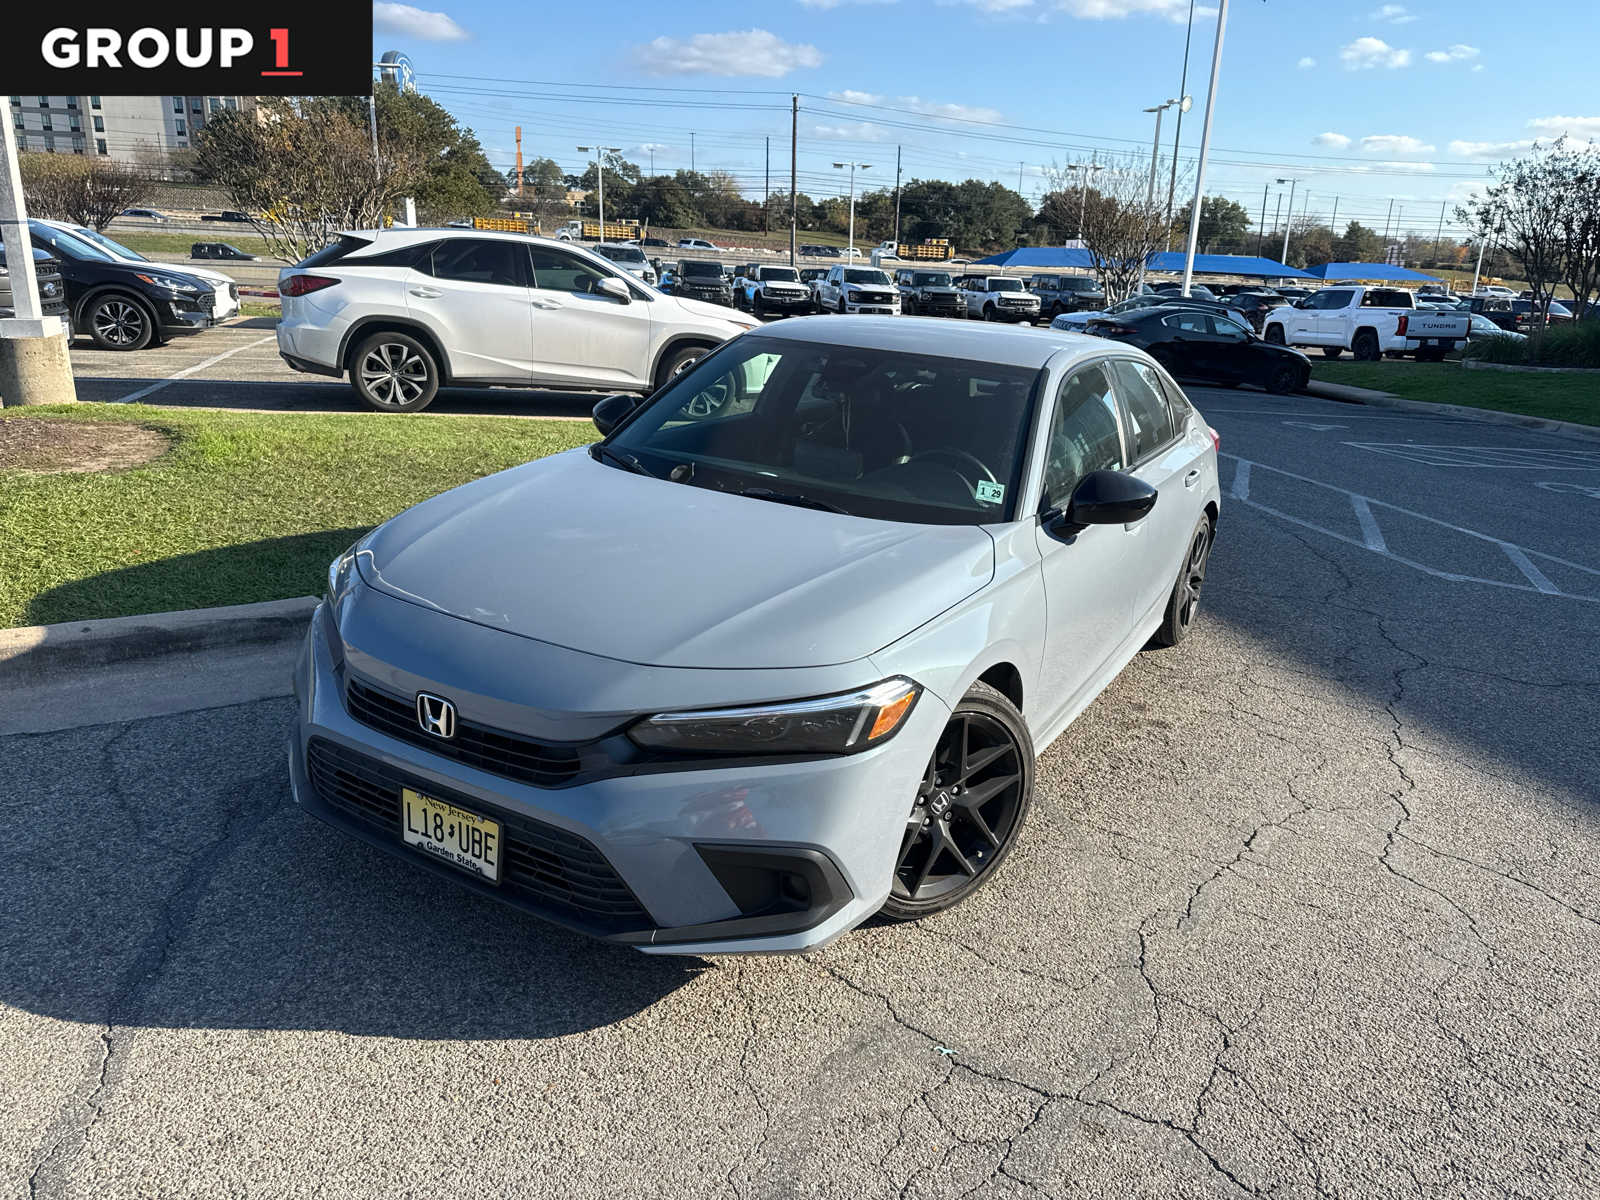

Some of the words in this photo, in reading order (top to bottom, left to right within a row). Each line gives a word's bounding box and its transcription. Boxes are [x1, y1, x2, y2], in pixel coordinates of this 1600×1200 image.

[991, 489, 1001, 498] 29
[425, 796, 447, 811] New
[448, 805, 477, 824] Jersey
[426, 841, 454, 859] Garden
[457, 853, 477, 868] State
